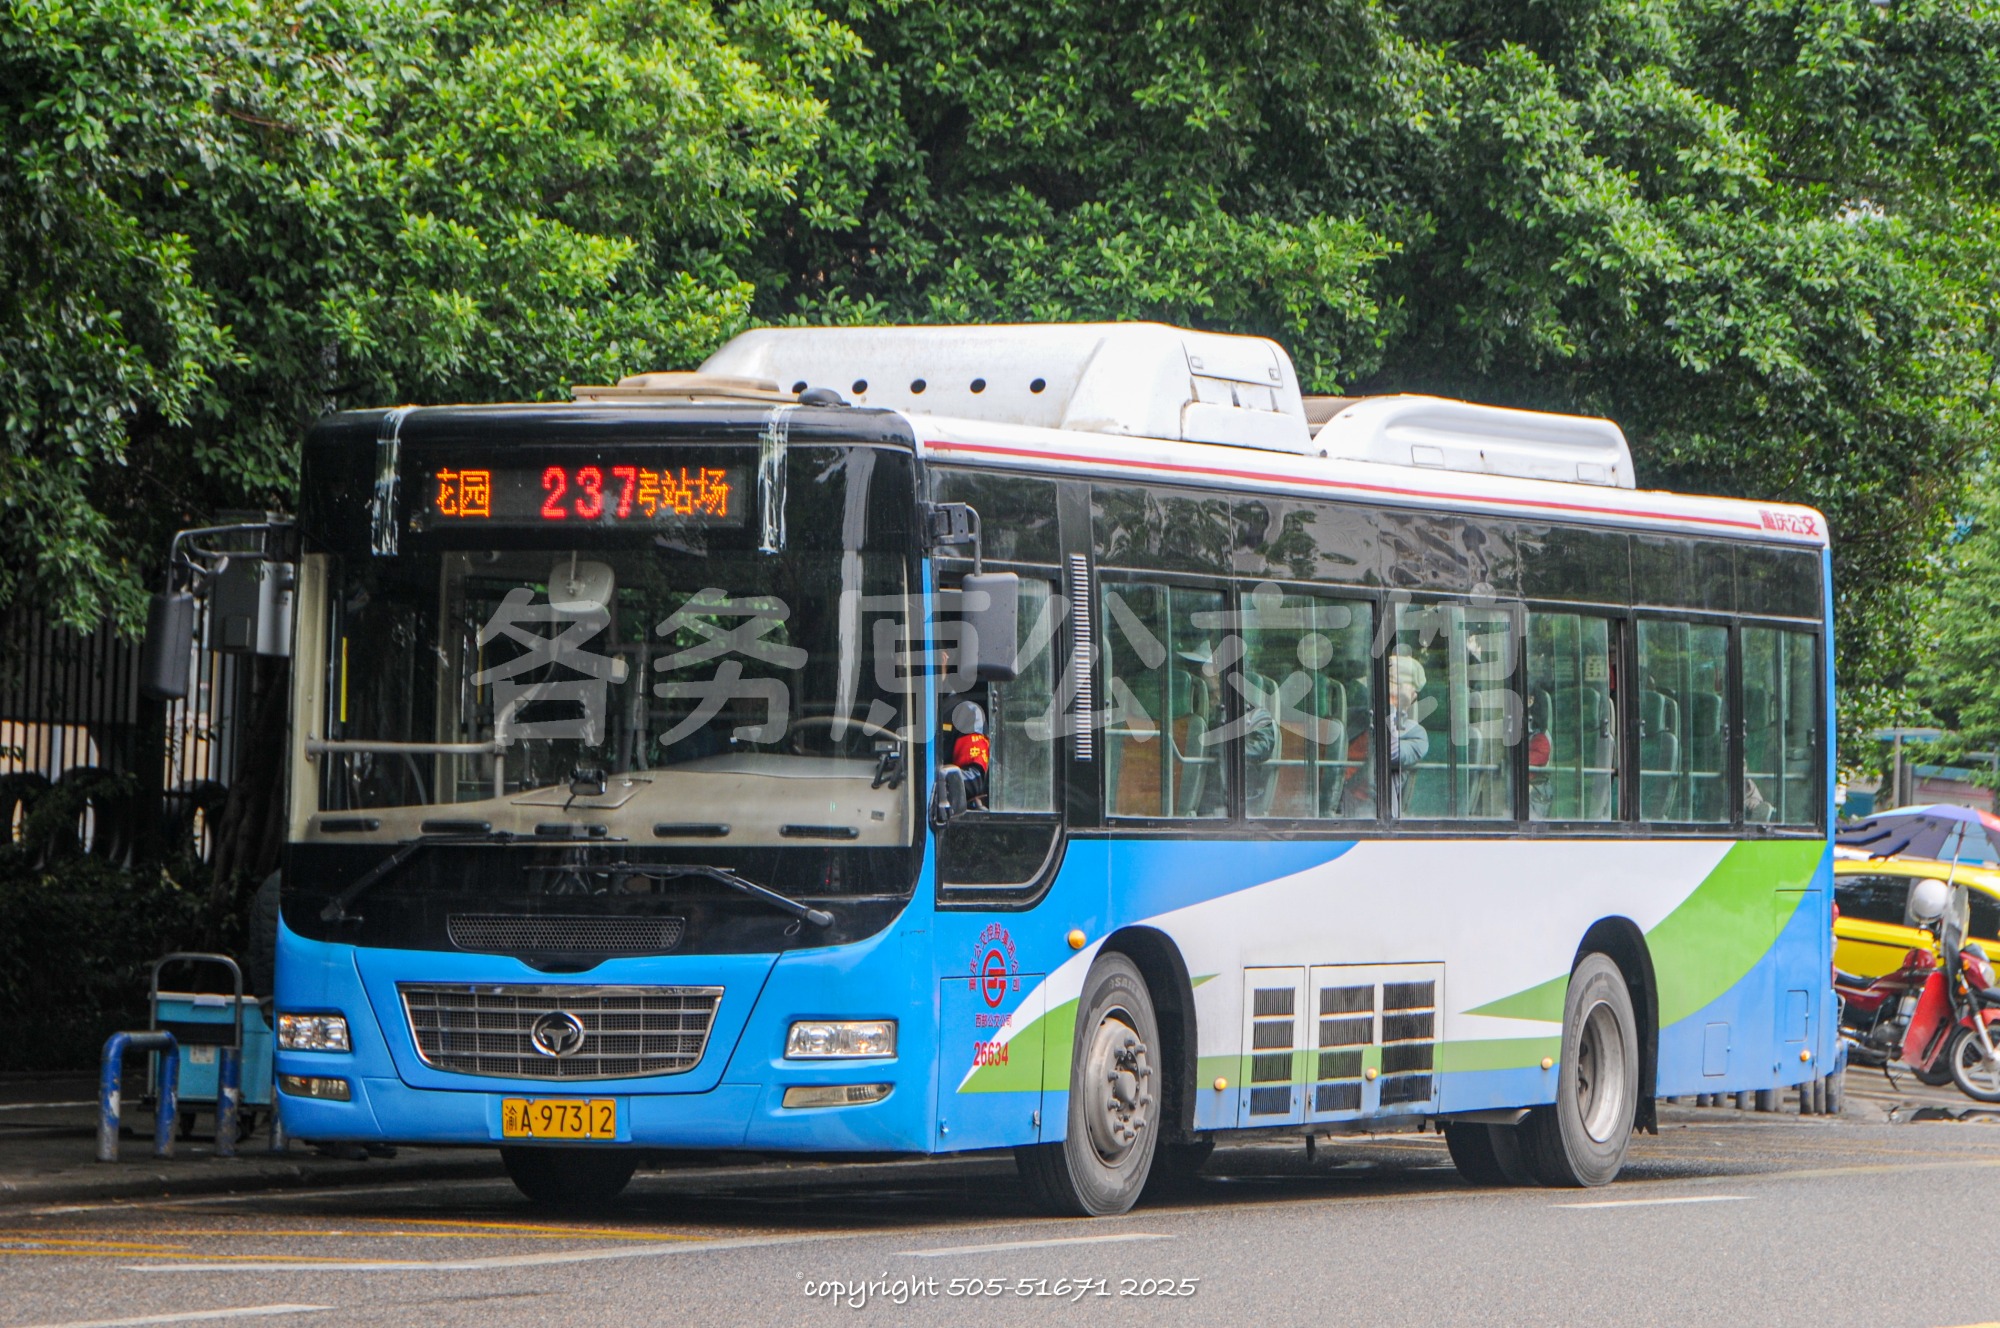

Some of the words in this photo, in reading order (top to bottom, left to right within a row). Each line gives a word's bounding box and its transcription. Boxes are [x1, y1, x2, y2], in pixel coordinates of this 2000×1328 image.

[541, 467, 636, 518] 237
[1760, 511, 1819, 536] 重庆公交
[975, 1013, 1012, 1027] 西部公交公司
[973, 1041, 1009, 1067] 26634
